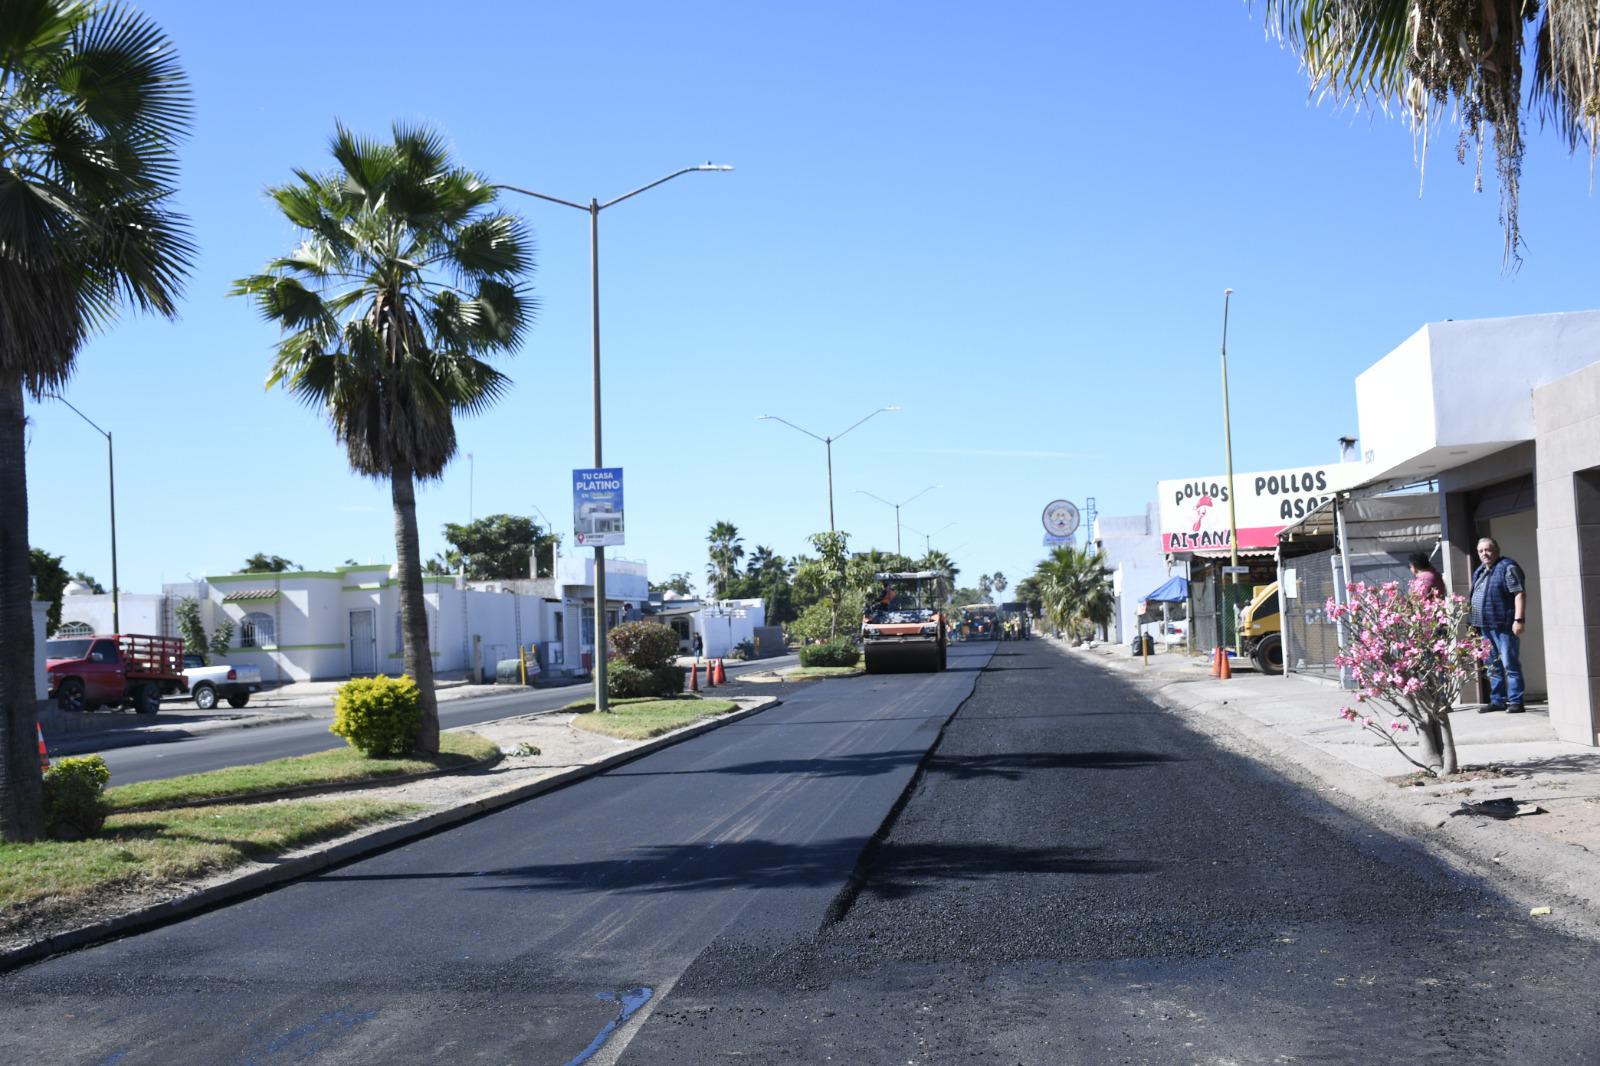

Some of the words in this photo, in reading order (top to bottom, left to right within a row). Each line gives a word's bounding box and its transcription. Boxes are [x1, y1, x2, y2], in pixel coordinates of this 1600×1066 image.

[576, 480, 620, 490] PLATINO
[1175, 481, 1229, 506] POLLOS
[1255, 470, 1327, 496] POLLOS
